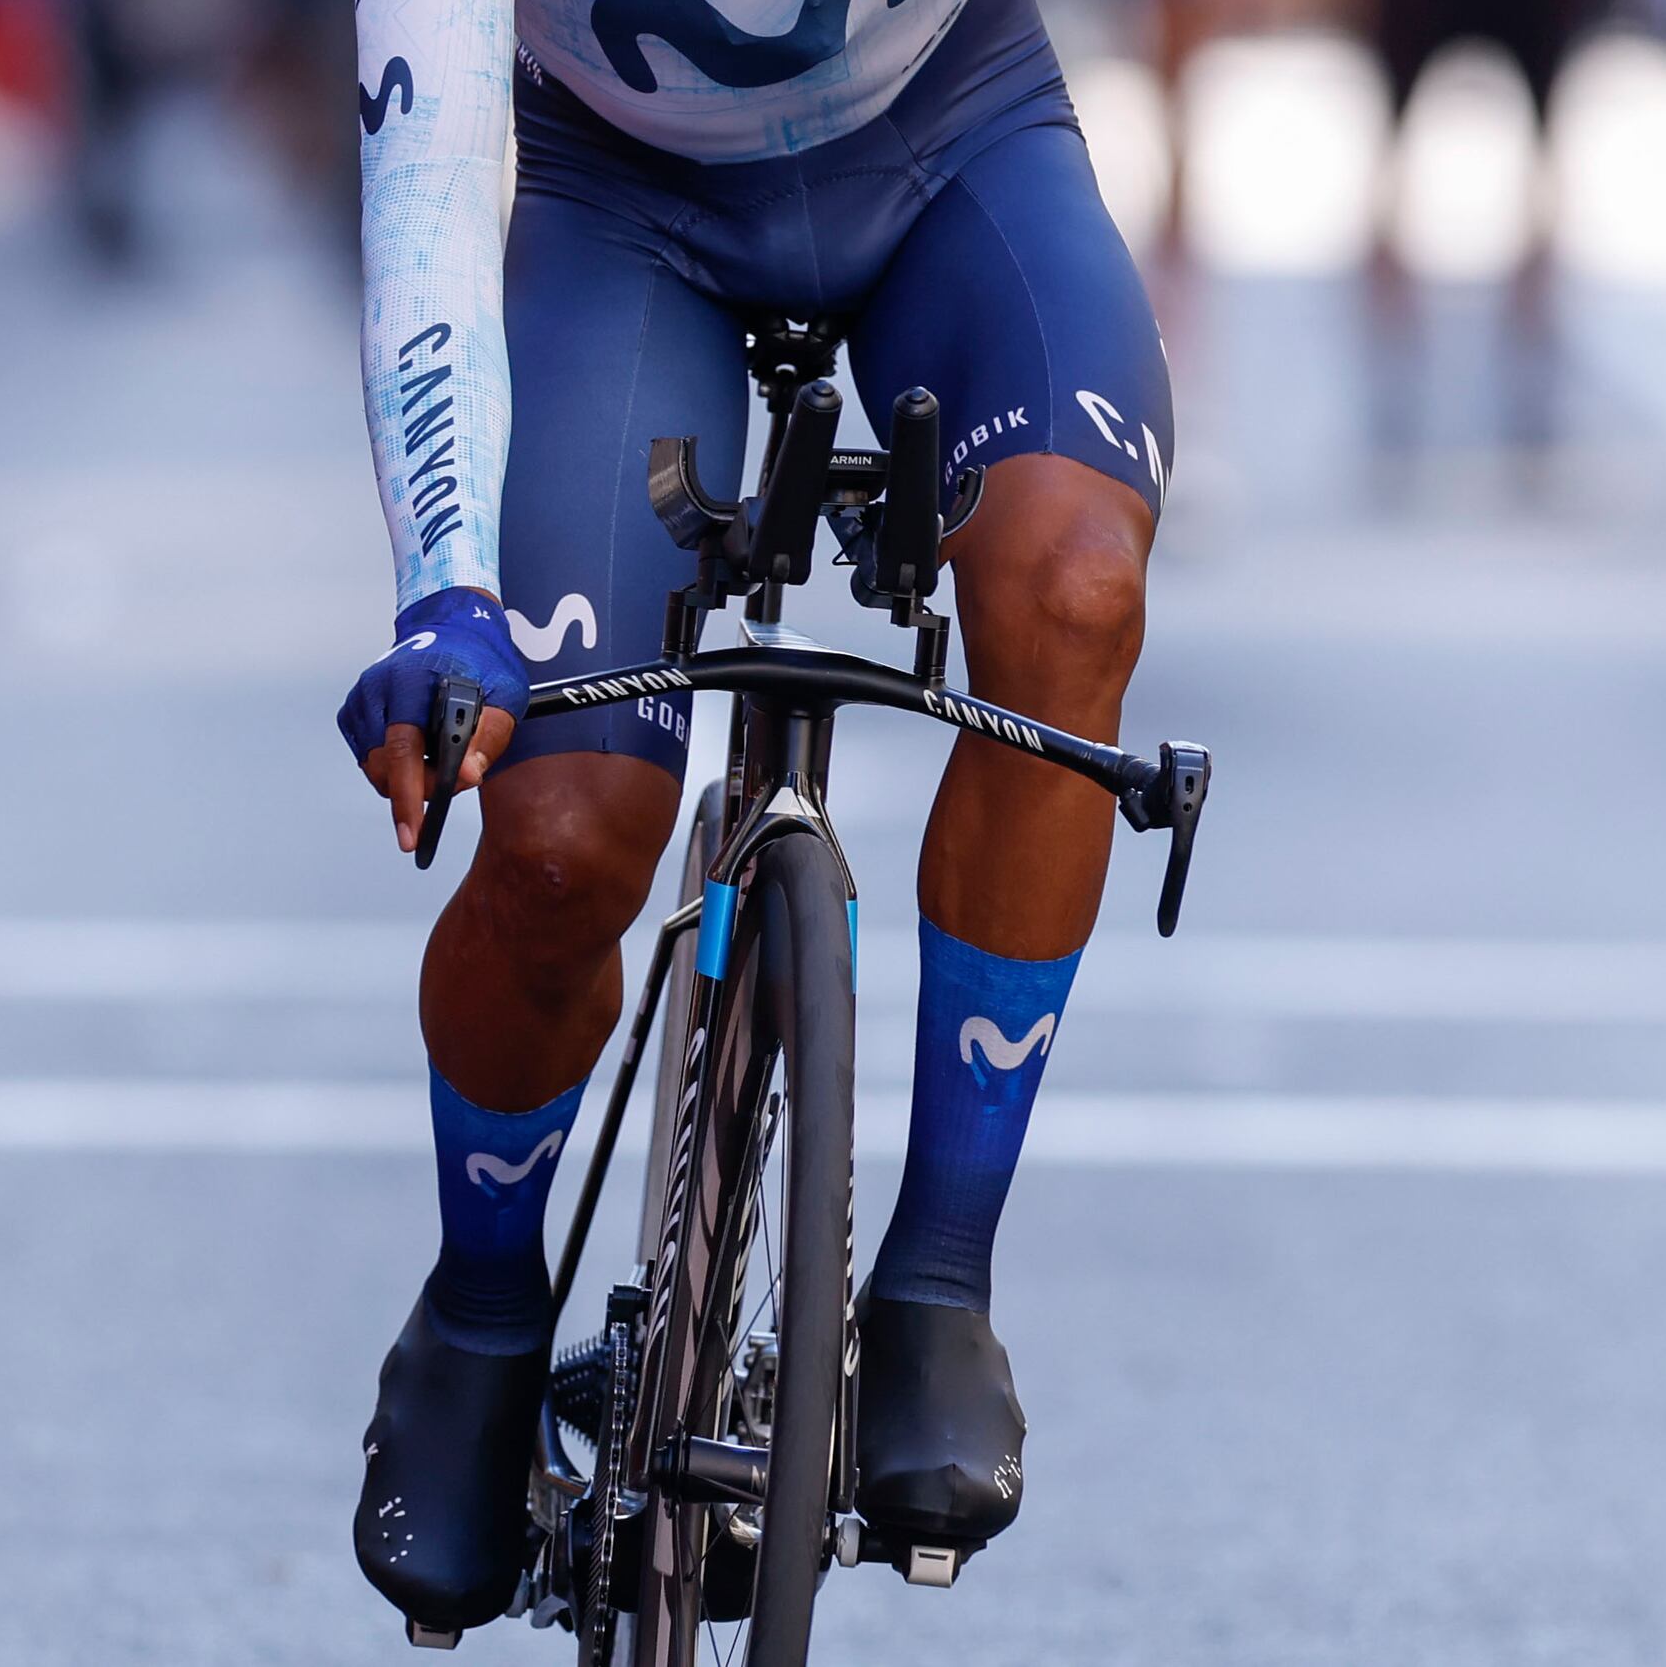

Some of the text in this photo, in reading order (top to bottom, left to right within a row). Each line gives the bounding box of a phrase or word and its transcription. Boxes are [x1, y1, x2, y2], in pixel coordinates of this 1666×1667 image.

[398, 322, 464, 559] CANYON
[830, 455, 873, 465] ARMIN
[945, 406, 1030, 486] GOBIK
[562, 668, 694, 705] CANYON
[638, 696, 690, 750] GOBI
[923, 689, 1045, 752] CANYON
